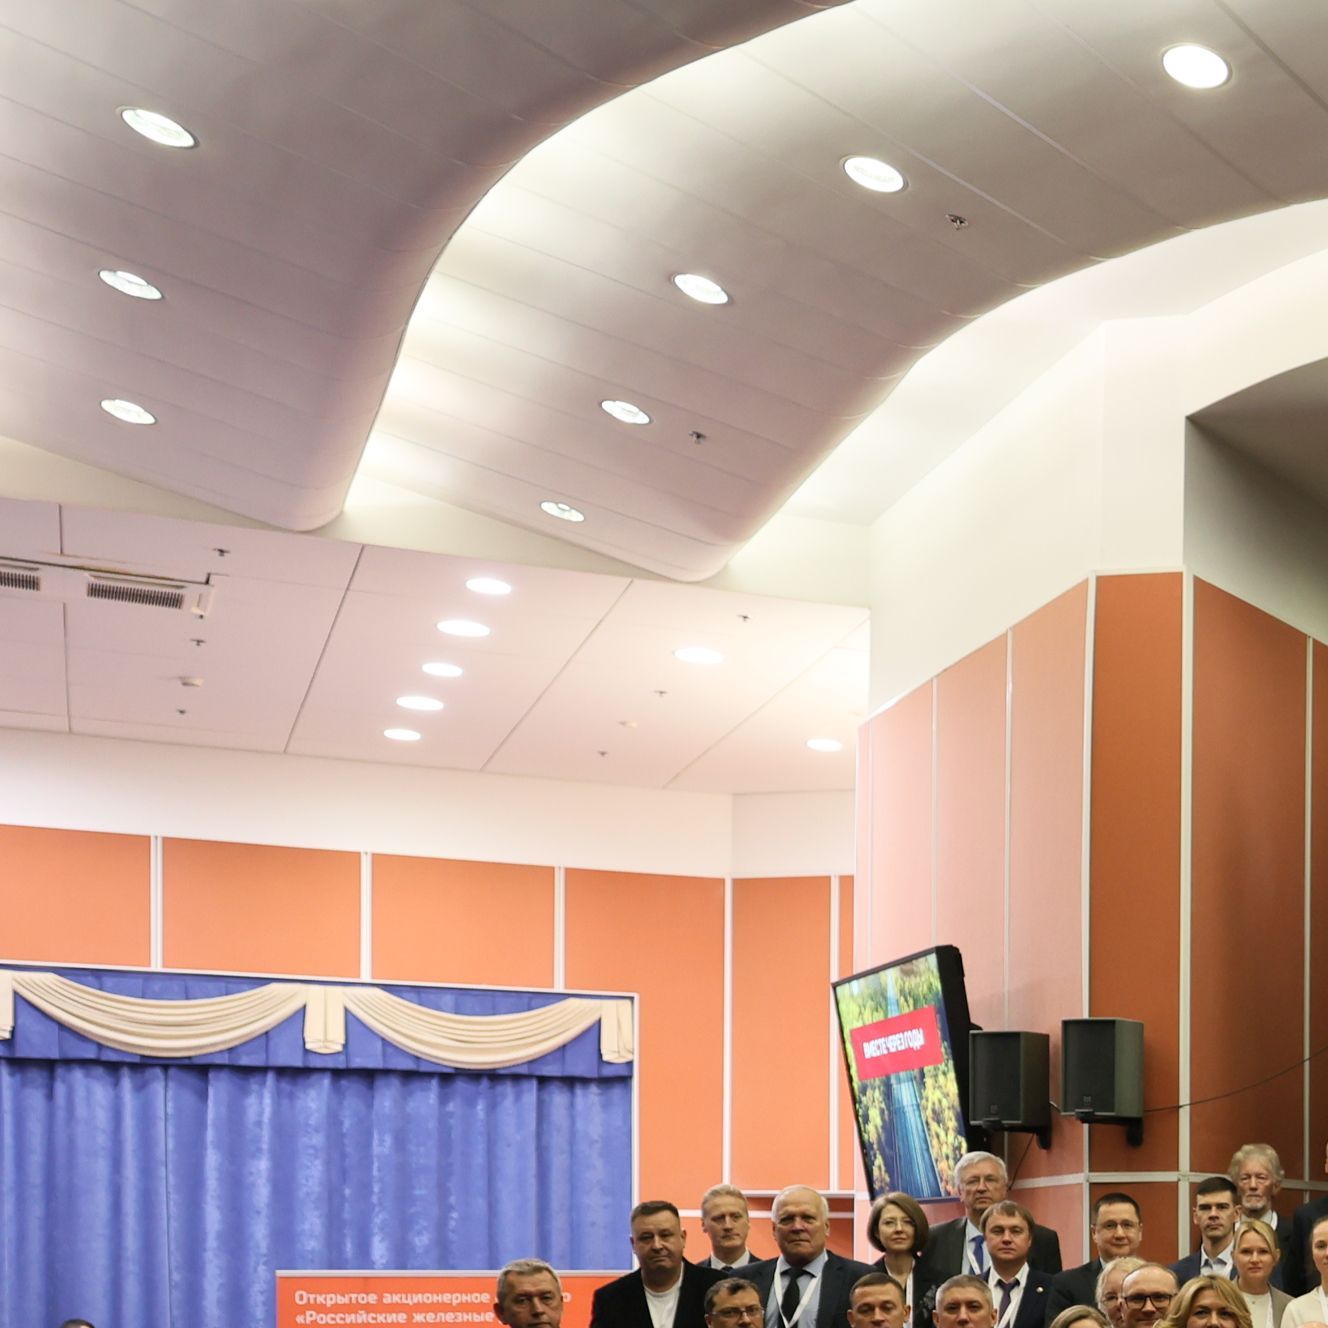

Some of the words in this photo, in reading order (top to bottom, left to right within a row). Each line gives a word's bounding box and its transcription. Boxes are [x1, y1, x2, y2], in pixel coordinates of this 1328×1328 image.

[294, 1290, 377, 1306] Открытое
[382, 1290, 491, 1306] акционерное
[295, 1310, 406, 1325] «Российские
[412, 1310, 495, 1324] железные
